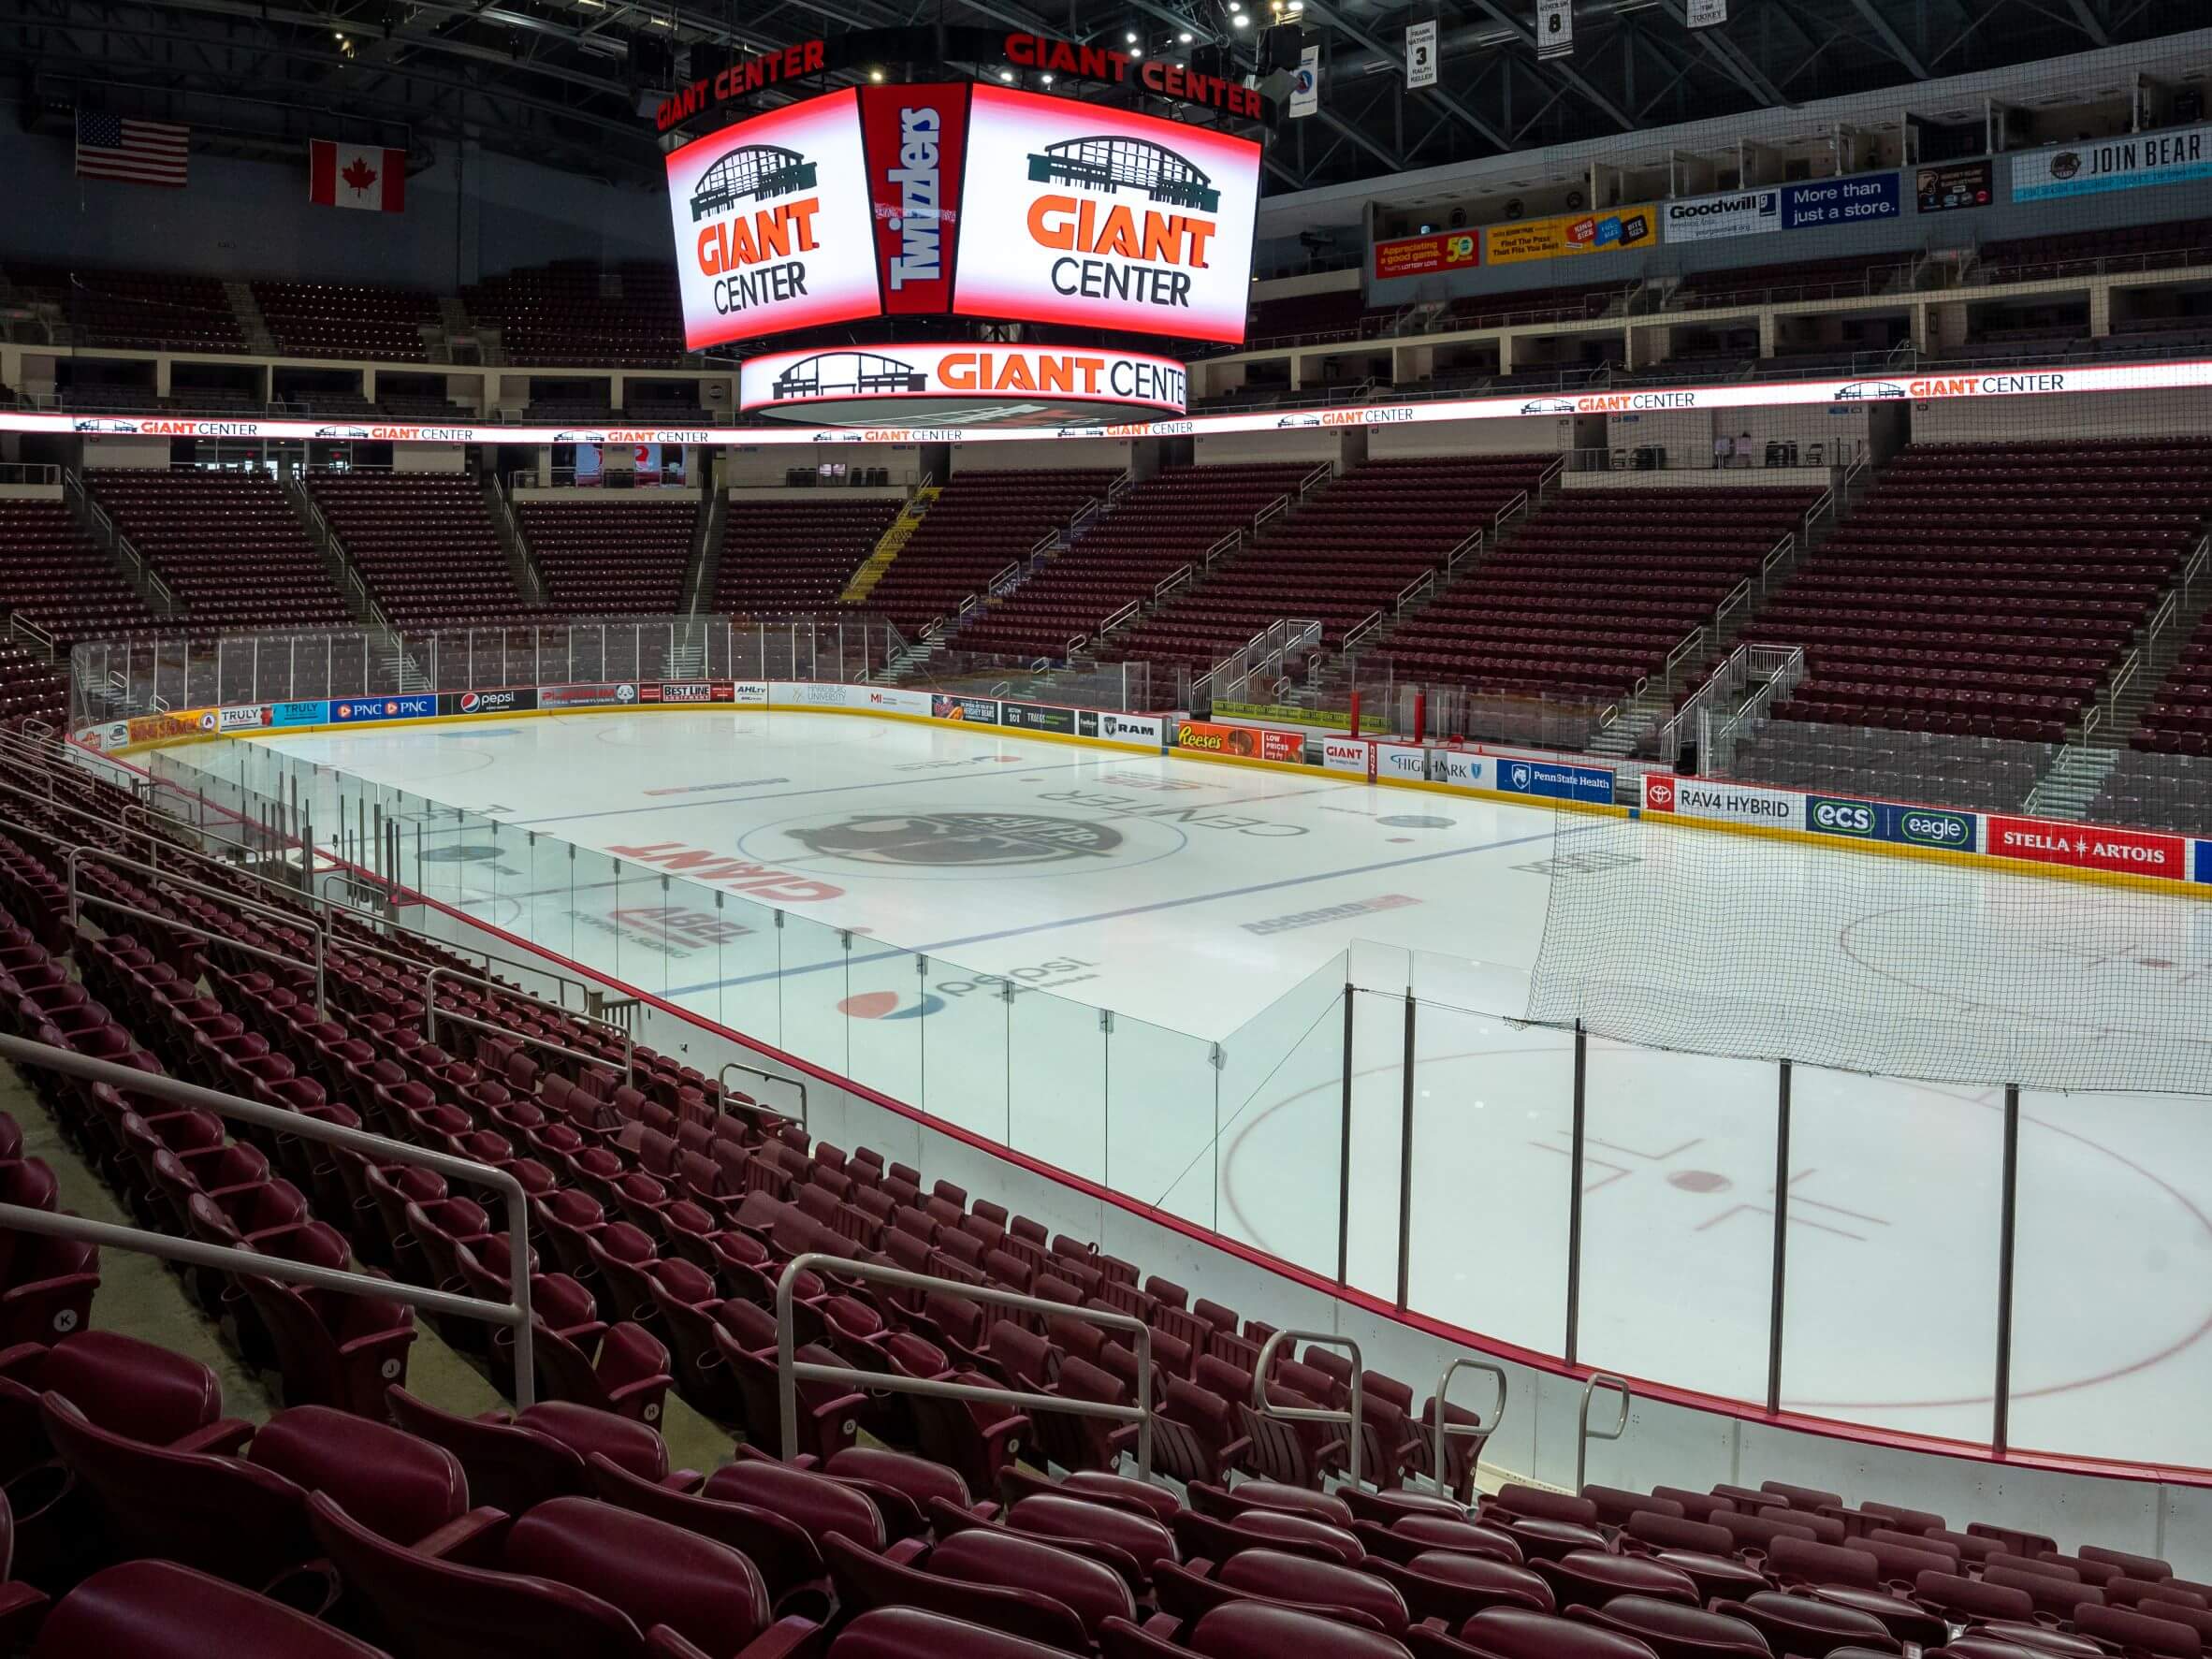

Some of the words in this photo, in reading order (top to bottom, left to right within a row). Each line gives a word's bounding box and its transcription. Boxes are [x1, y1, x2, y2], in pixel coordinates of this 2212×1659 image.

[1550, 13, 1561, 32] 8
[1692, 11, 1722, 23] TOOKEY
[1411, 29, 1431, 37] FRANK
[1416, 46, 1427, 65] 3
[1005, 34, 1128, 82] GIANT
[1142, 61, 1261, 120] CENTER
[1410, 73, 1433, 83] KELLER
[1412, 66, 1432, 76] RALPH
[657, 79, 706, 131] GIANT
[714, 39, 825, 100] CENTER
[2091, 143, 2136, 174] JOIN
[2146, 134, 2201, 167] BEAR
[891, 107, 940, 290] Twizzlers
[1794, 187, 1838, 204] More
[1842, 182, 1881, 197] than
[1670, 196, 1756, 219] Goodwill
[1793, 210, 1825, 229] just
[1828, 209, 1840, 218] a
[1843, 199, 1896, 216] store.
[1026, 194, 1215, 269] GIANT
[1574, 220, 1594, 233] KING
[1627, 219, 1643, 230] BITE
[697, 197, 820, 276] GIANT
[1577, 229, 1594, 240] SIZE
[1628, 226, 1644, 238] SIZE
[1383, 241, 1438, 255] Appreciating
[1526, 244, 1540, 253] You
[1542, 242, 1559, 251] Best
[1387, 252, 1411, 265] good
[1402, 261, 1423, 269] LOTTERY
[714, 261, 808, 315] CENTER
[1051, 256, 1191, 308] CENTER
[937, 353, 1104, 393] GIANT
[1909, 378, 1980, 398] GIANT
[1983, 374, 2064, 393] CENTER
[1578, 396, 1631, 412] GIANT
[1633, 393, 1695, 409] CENTER
[1322, 412, 1363, 425] GIANT
[1365, 408, 1414, 423] CENTER
[141, 421, 196, 435] GIANT
[199, 422, 258, 436] CENTER
[372, 428, 421, 440] GIANT
[423, 429, 474, 441] CENTER
[865, 430, 910, 442] GIANT
[913, 429, 963, 441] CENTER
[1107, 424, 1151, 436] GIANT
[1153, 422, 1193, 435] CENTER
[608, 431, 656, 443] GIANT
[658, 431, 709, 443] CENTER
[664, 686, 688, 696] BEST
[690, 685, 709, 696] LINE
[808, 691, 846, 702] UNIVERSITY
[481, 691, 515, 706] pepsi
[870, 693, 882, 704] MI
[284, 703, 318, 713] TRULY
[354, 703, 382, 717] PNC
[400, 700, 428, 713] PNC
[222, 708, 258, 721] TRULY
[1118, 722, 1155, 736] RAM
[1179, 726, 1223, 749] Reese's
[1265, 734, 1281, 742] LOW
[1265, 742, 1289, 751] PRICES
[1326, 746, 1363, 760] GIANT
[1579, 776, 1610, 790] Health
[1681, 789, 1722, 810] RAV4
[1726, 795, 1790, 819] HYBRID
[1037, 791, 1310, 837] CENTER
[1817, 803, 1870, 830] ecs
[1908, 815, 1961, 841] eagle
[2003, 830, 2070, 852] STELLA
[2092, 841, 2165, 865] ARTOIS
[604, 842, 846, 902] GIANT
[936, 956, 1101, 997] pepsi
[61, 1315, 71, 1326] K
[387, 1363, 394, 1374] J
[648, 1407, 656, 1416] H
